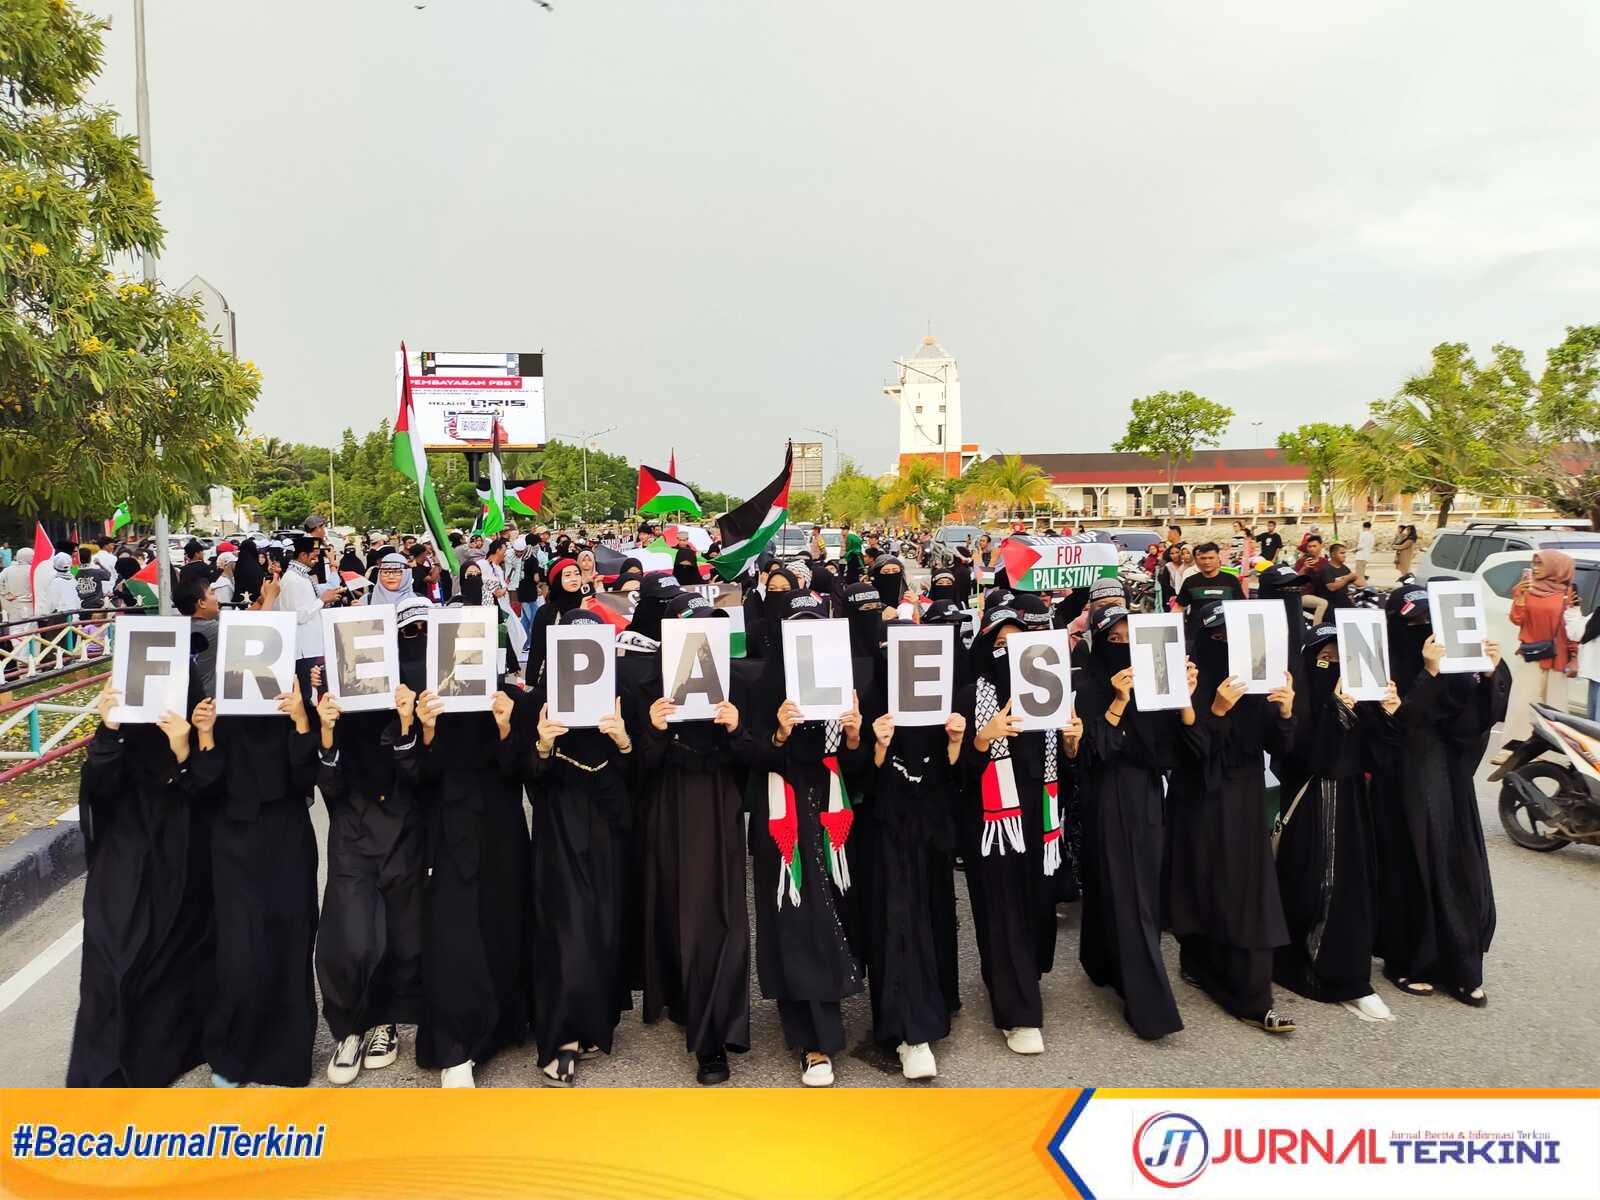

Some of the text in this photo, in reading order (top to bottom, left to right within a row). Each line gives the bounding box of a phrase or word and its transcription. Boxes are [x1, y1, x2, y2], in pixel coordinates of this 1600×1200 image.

[1033, 566, 1104, 590] PALESTINE
[1057, 546, 1082, 566] FOR
[333, 619, 391, 697] E
[438, 622, 486, 696] E
[1135, 625, 1179, 696] T
[1247, 613, 1267, 681] I
[1343, 622, 1389, 688] N
[1439, 593, 1482, 658] E
[125, 631, 176, 706] F
[223, 625, 284, 701] R
[557, 638, 605, 713] P
[669, 632, 725, 705] A
[796, 635, 843, 706] L
[898, 640, 943, 712] E
[1019, 644, 1064, 717] S
